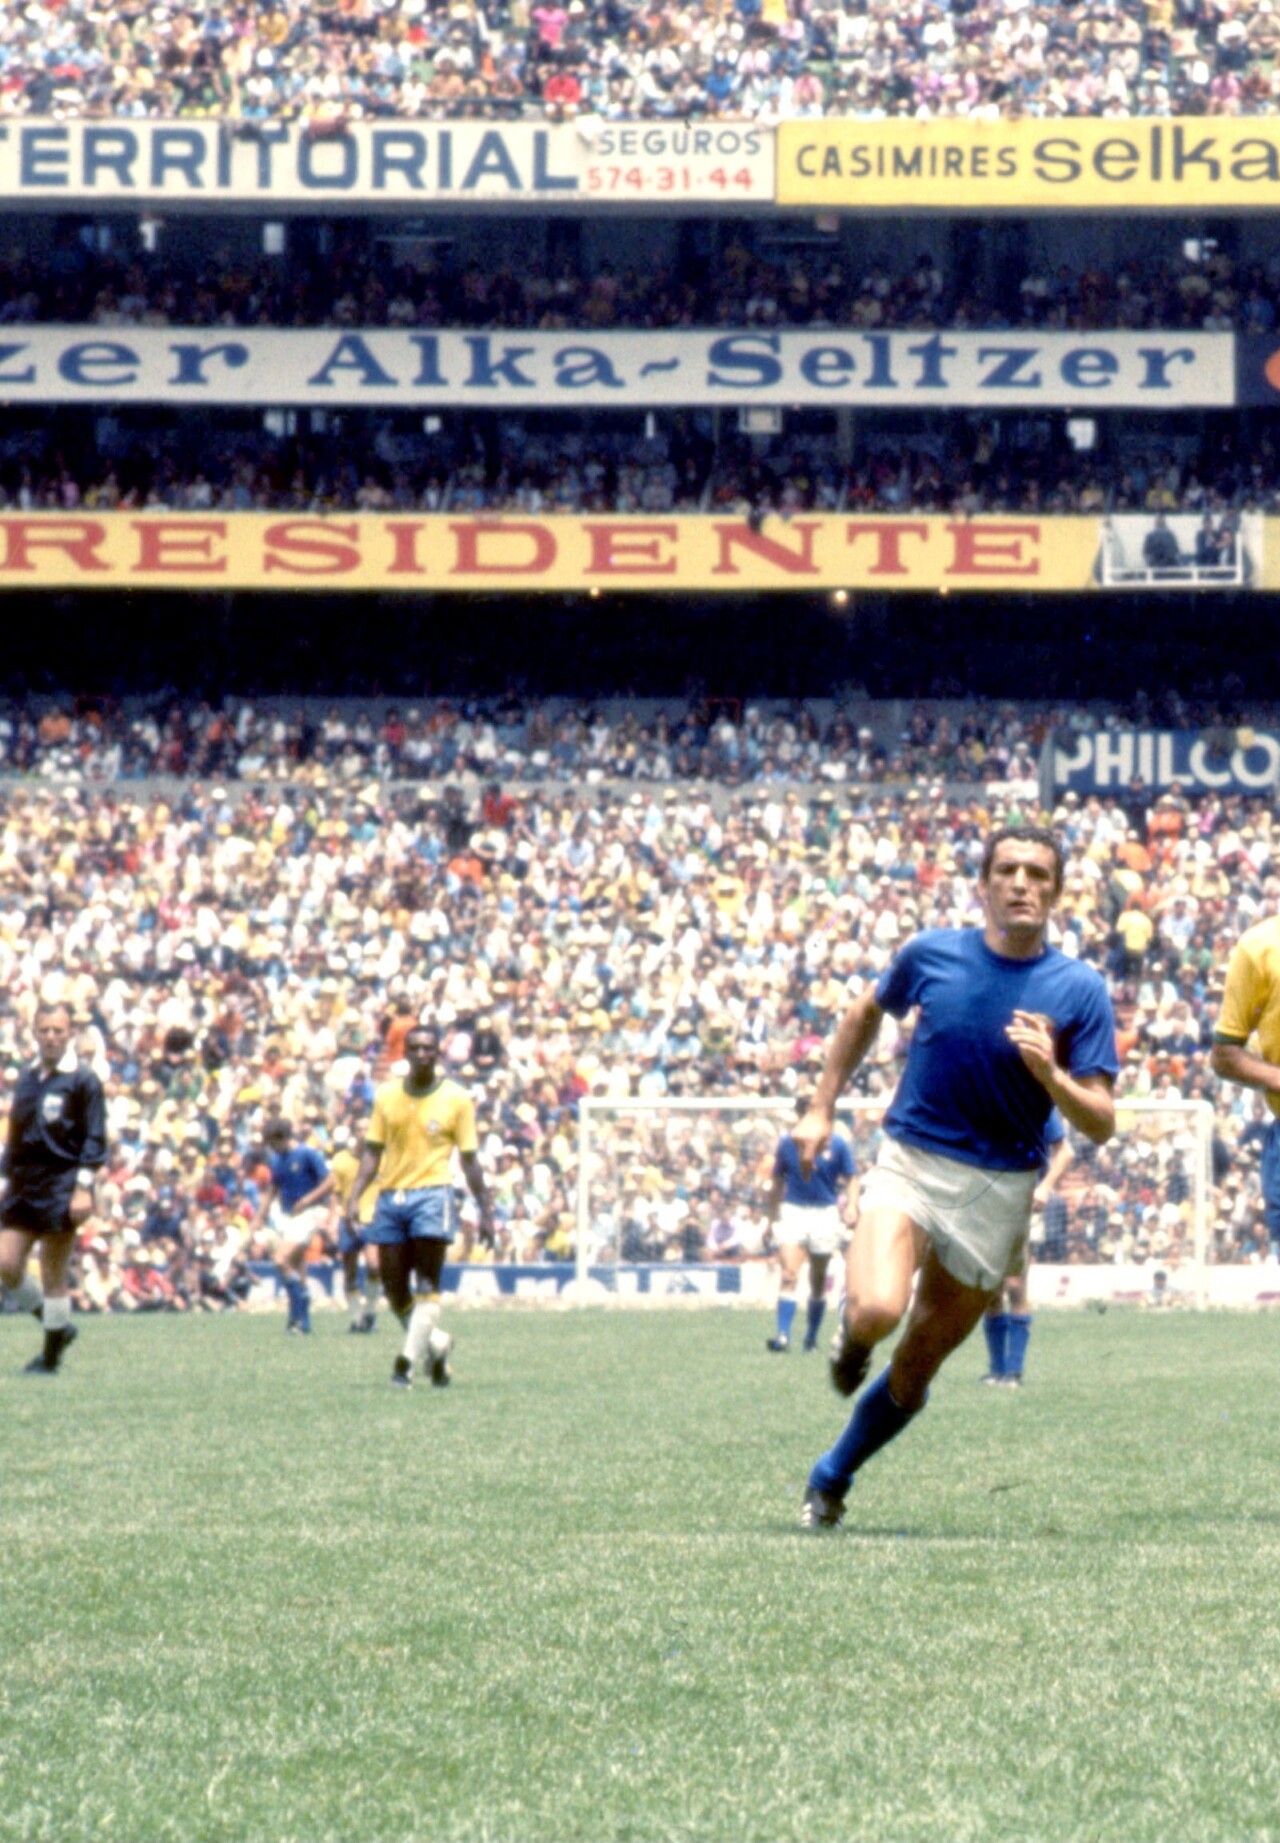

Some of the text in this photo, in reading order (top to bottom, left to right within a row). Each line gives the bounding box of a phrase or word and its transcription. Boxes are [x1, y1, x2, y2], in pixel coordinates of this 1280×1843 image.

[0, 125, 579, 190] ERRITORIAL
[598, 129, 761, 156] SEGUROS
[798, 144, 1018, 178] CASIMIRES
[307, 332, 1196, 390] Alka-Seltzer
